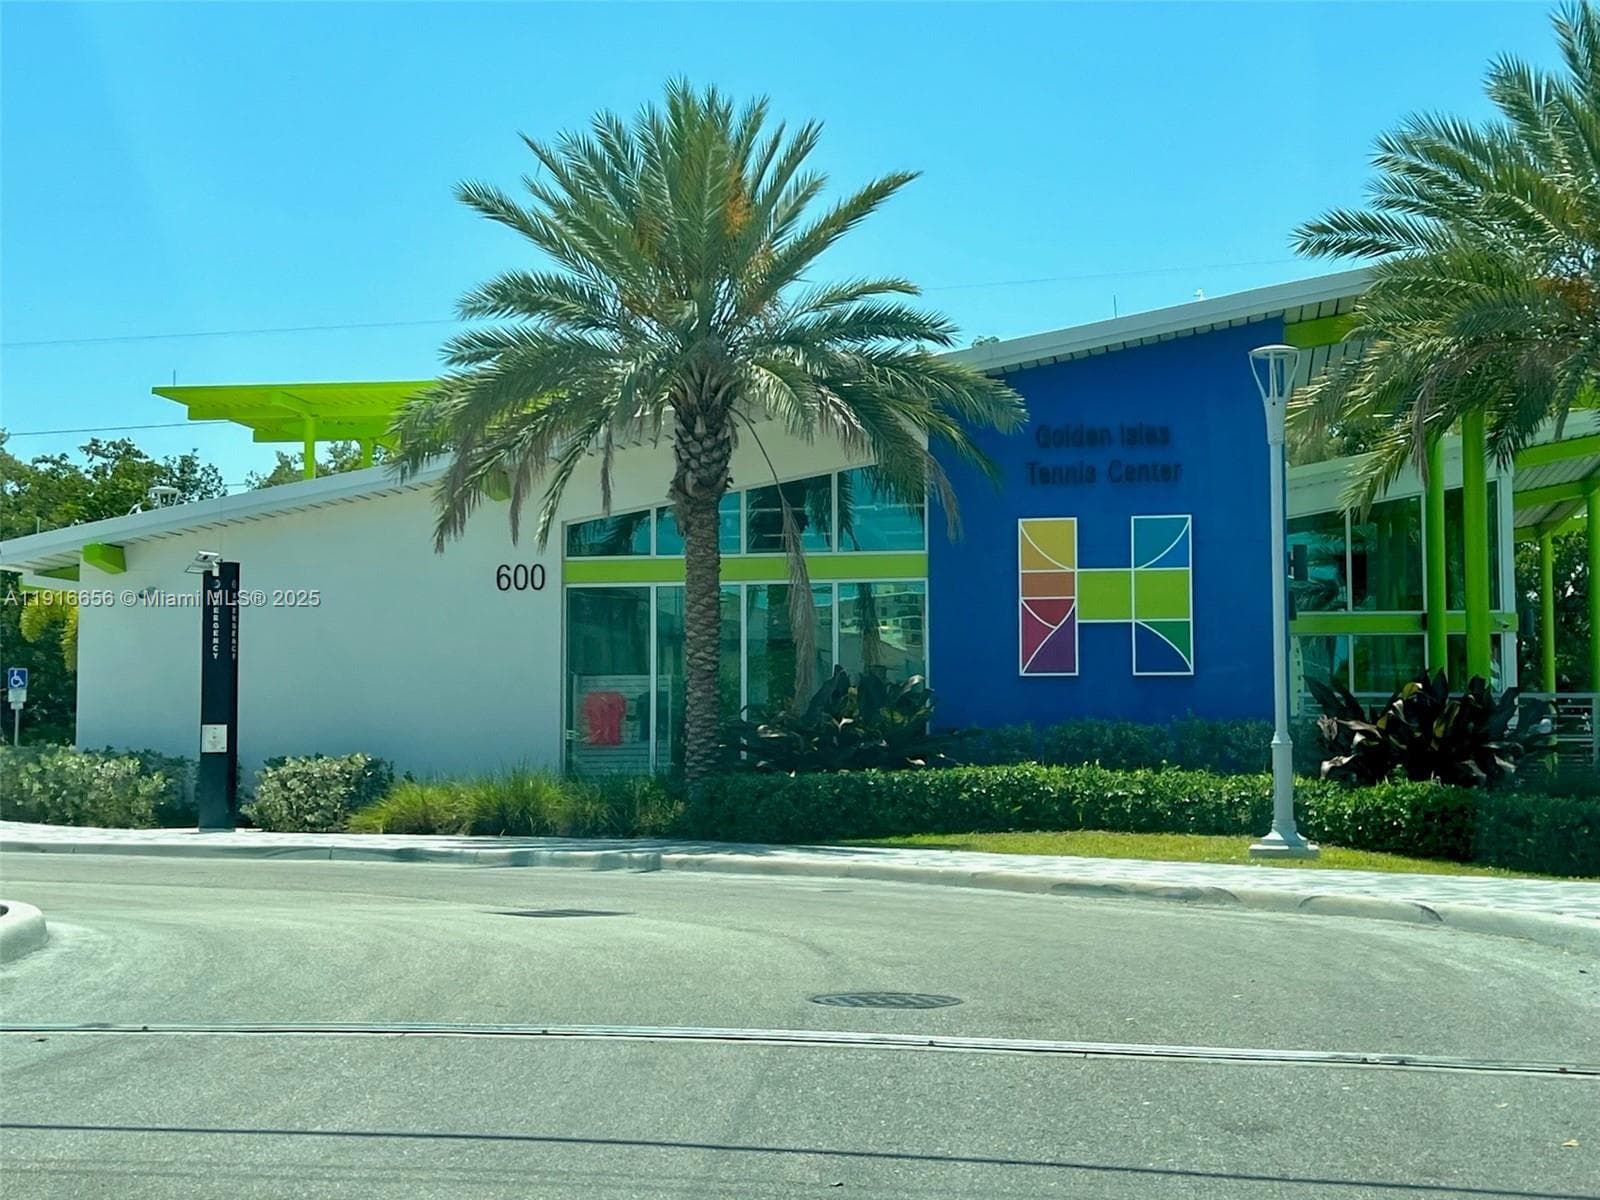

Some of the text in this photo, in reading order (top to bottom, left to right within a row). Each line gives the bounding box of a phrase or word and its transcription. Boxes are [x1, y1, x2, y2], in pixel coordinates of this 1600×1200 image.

[1036, 422, 1171, 448] Golden Isles
[1027, 459, 1182, 485] Tennis Center
[496, 563, 545, 591] 600
